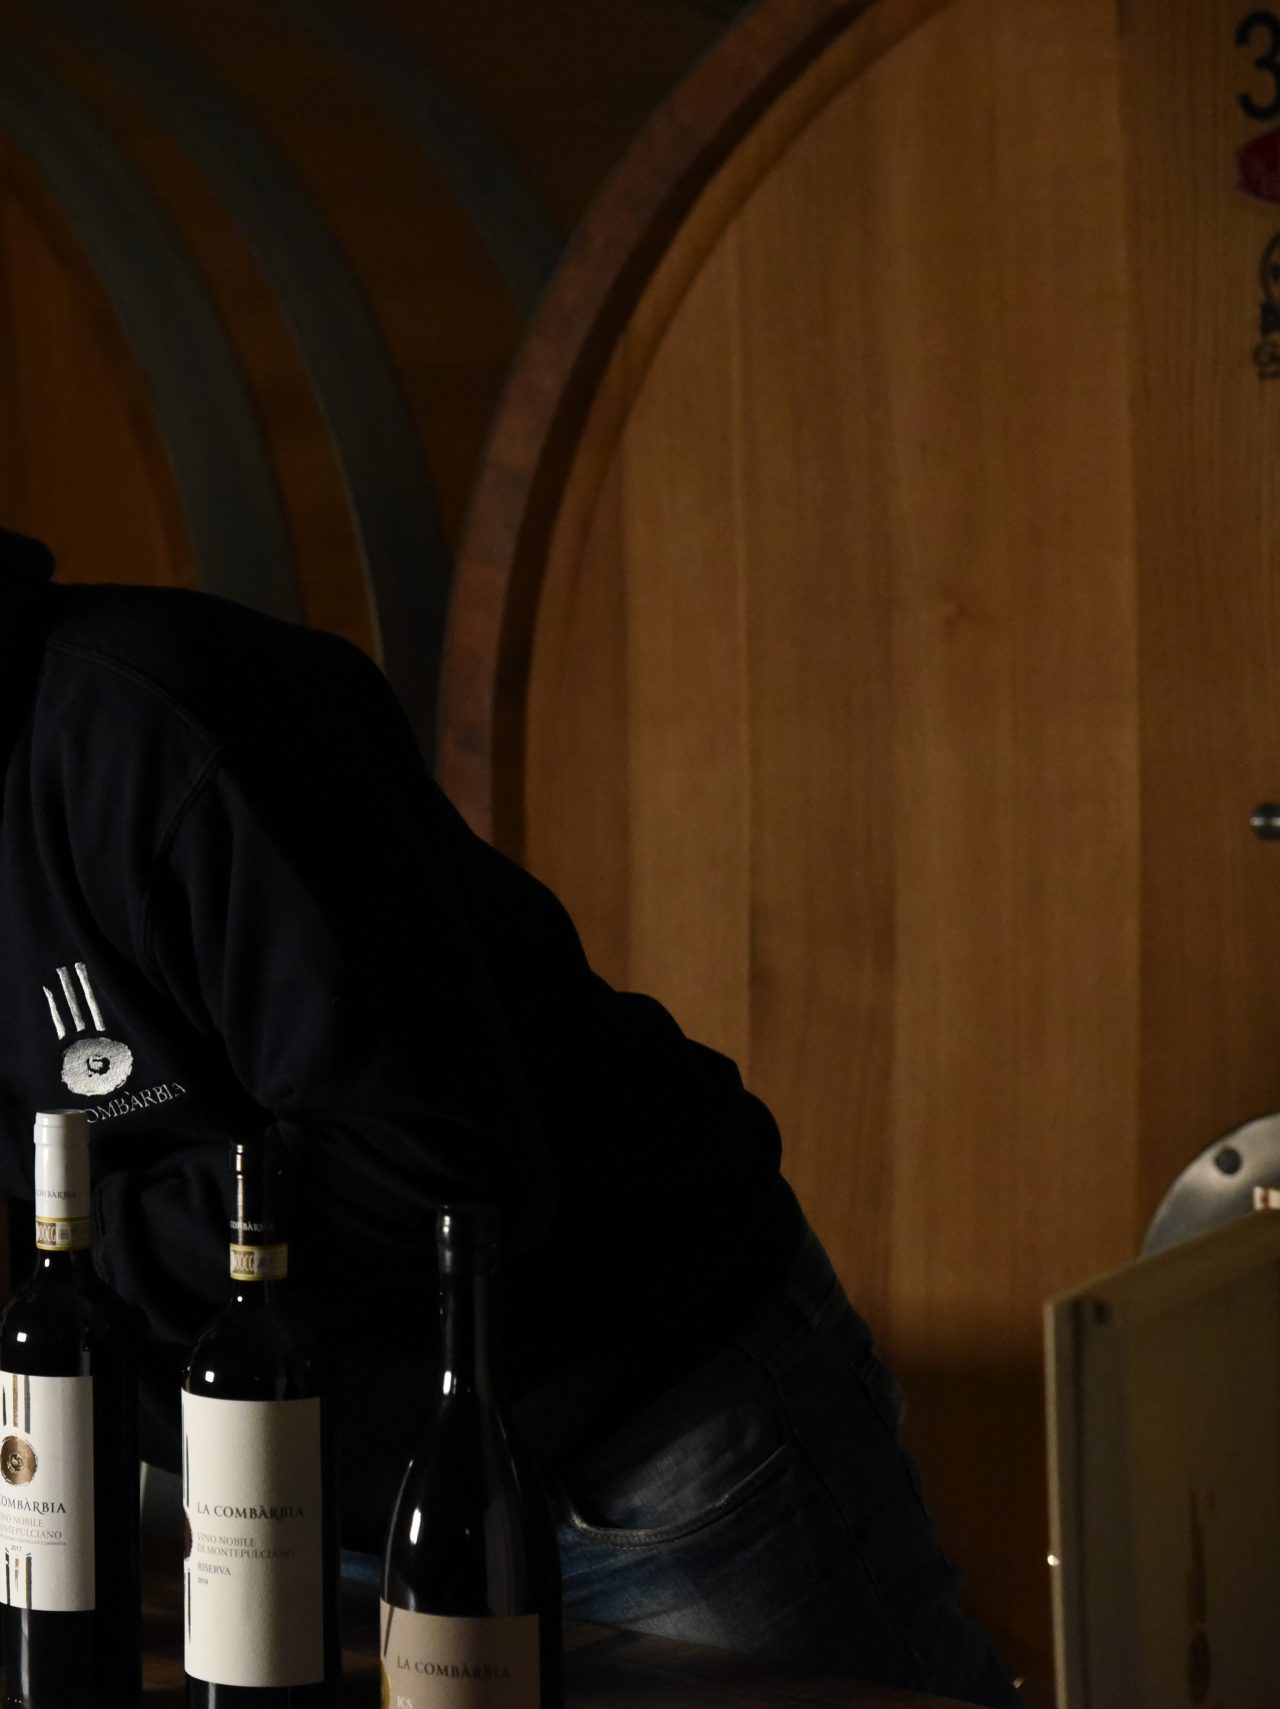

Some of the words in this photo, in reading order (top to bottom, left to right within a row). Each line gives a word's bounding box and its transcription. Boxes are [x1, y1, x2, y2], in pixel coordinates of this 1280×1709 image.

[85, 1082, 187, 1124] OMBÀRBIA
[197, 1501, 210, 1516] LA
[213, 1504, 305, 1522] COMBÀRBIA
[197, 1531, 217, 1544] VINO
[218, 1535, 256, 1548] NOBILE
[197, 1561, 232, 1576] RISERVA
[397, 1656, 411, 1671] LA
[414, 1661, 512, 1682] COMBÀRBIA
